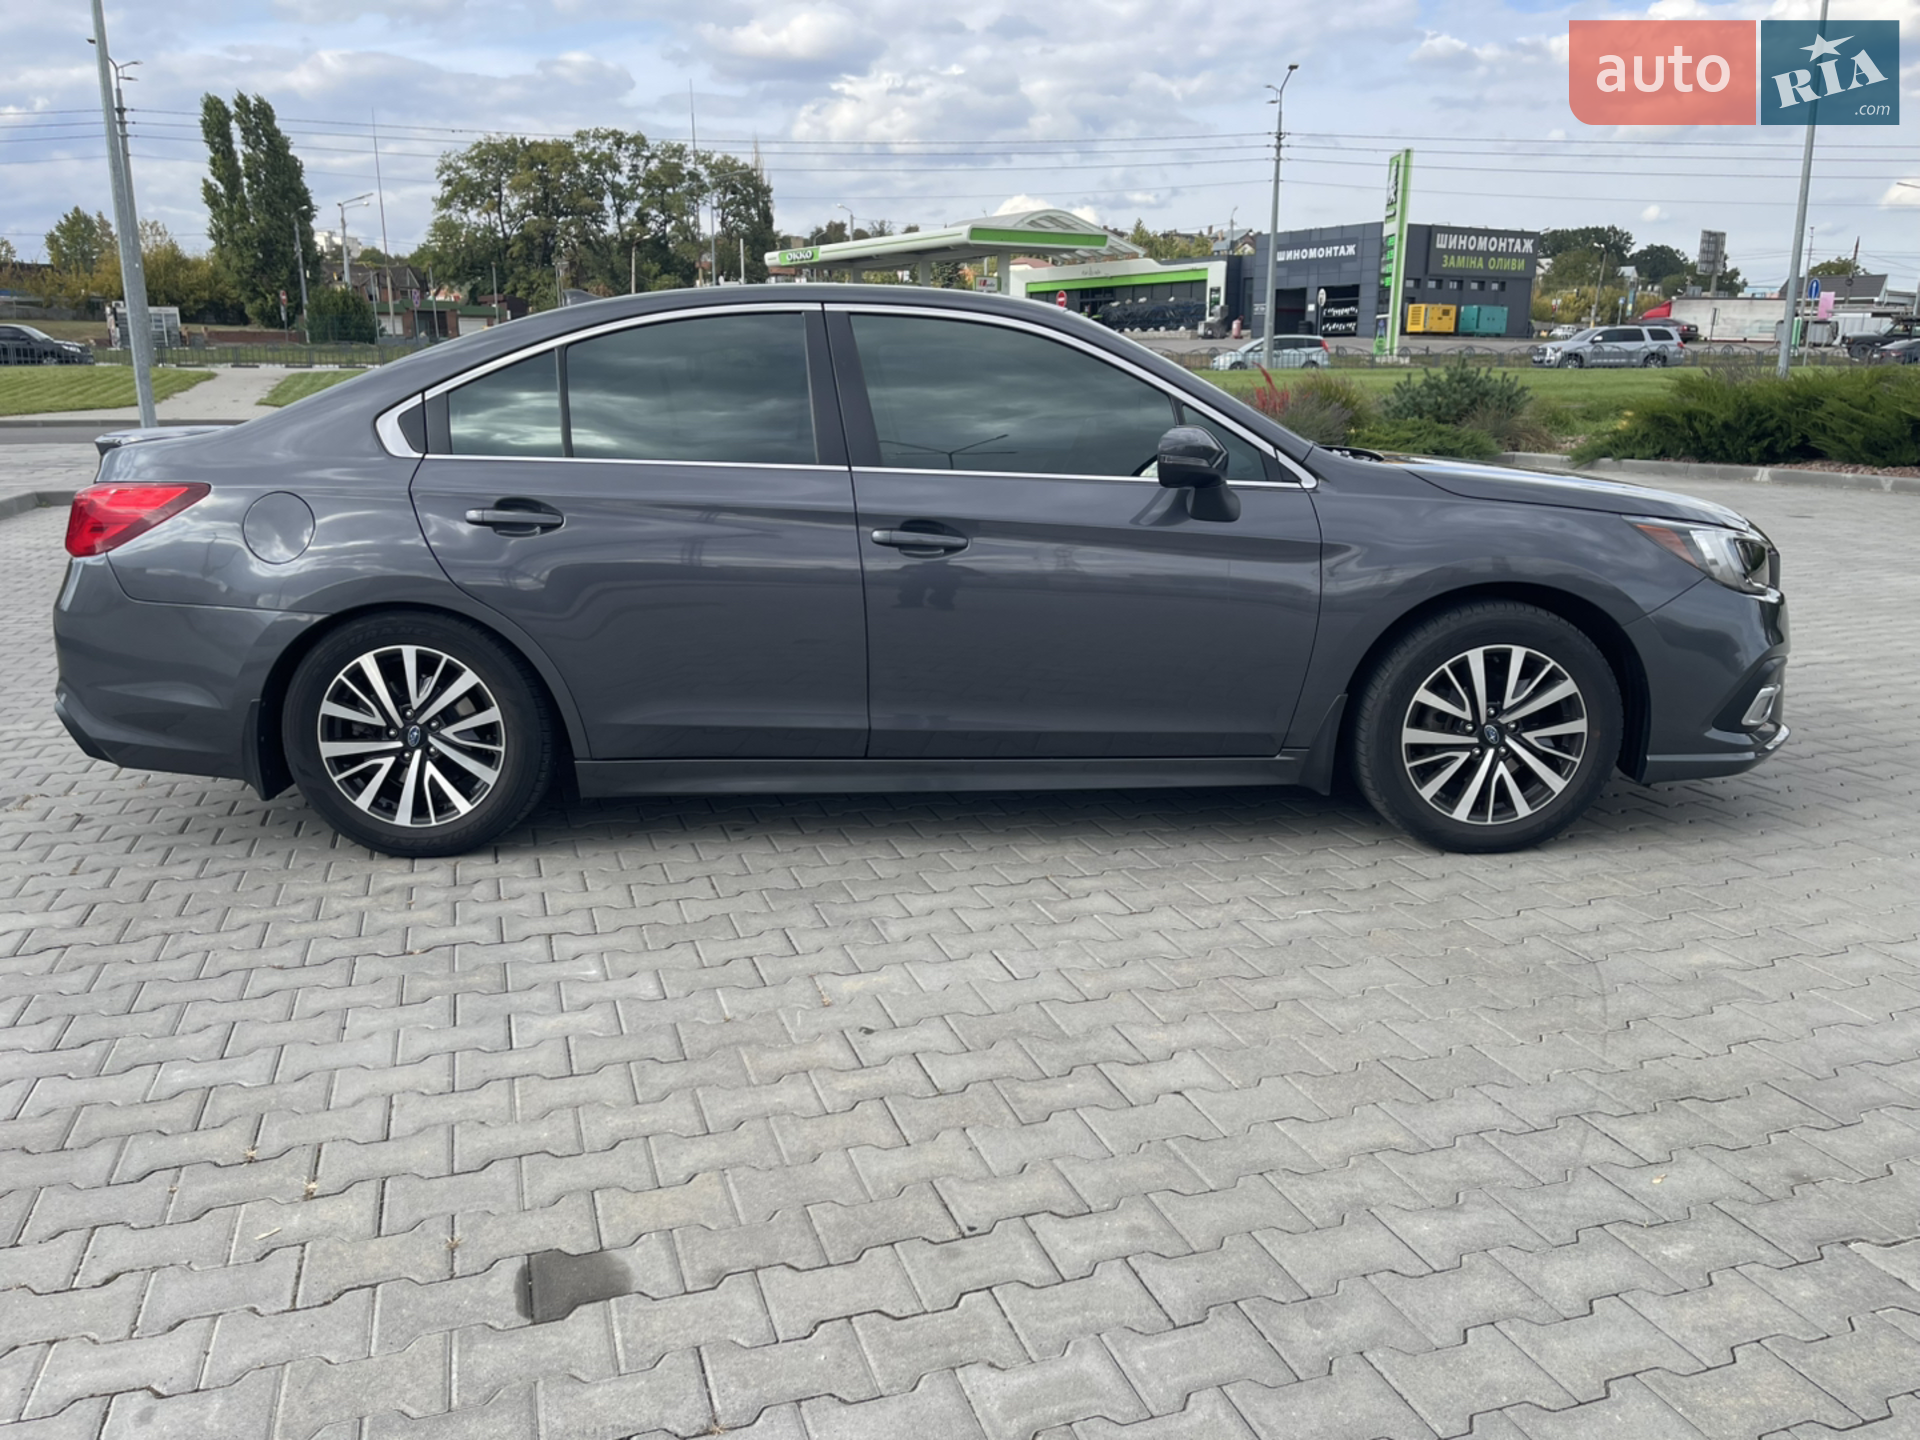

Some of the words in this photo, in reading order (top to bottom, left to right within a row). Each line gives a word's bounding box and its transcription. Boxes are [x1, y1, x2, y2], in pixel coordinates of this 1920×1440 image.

[1435, 233, 1534, 254] ШИНОМОНТАЖ
[1276, 244, 1356, 262] ШИНОМОНТАЖ
[1442, 254, 1484, 270] ЗАМІНА
[1488, 256, 1525, 271] ОЛИВИ
